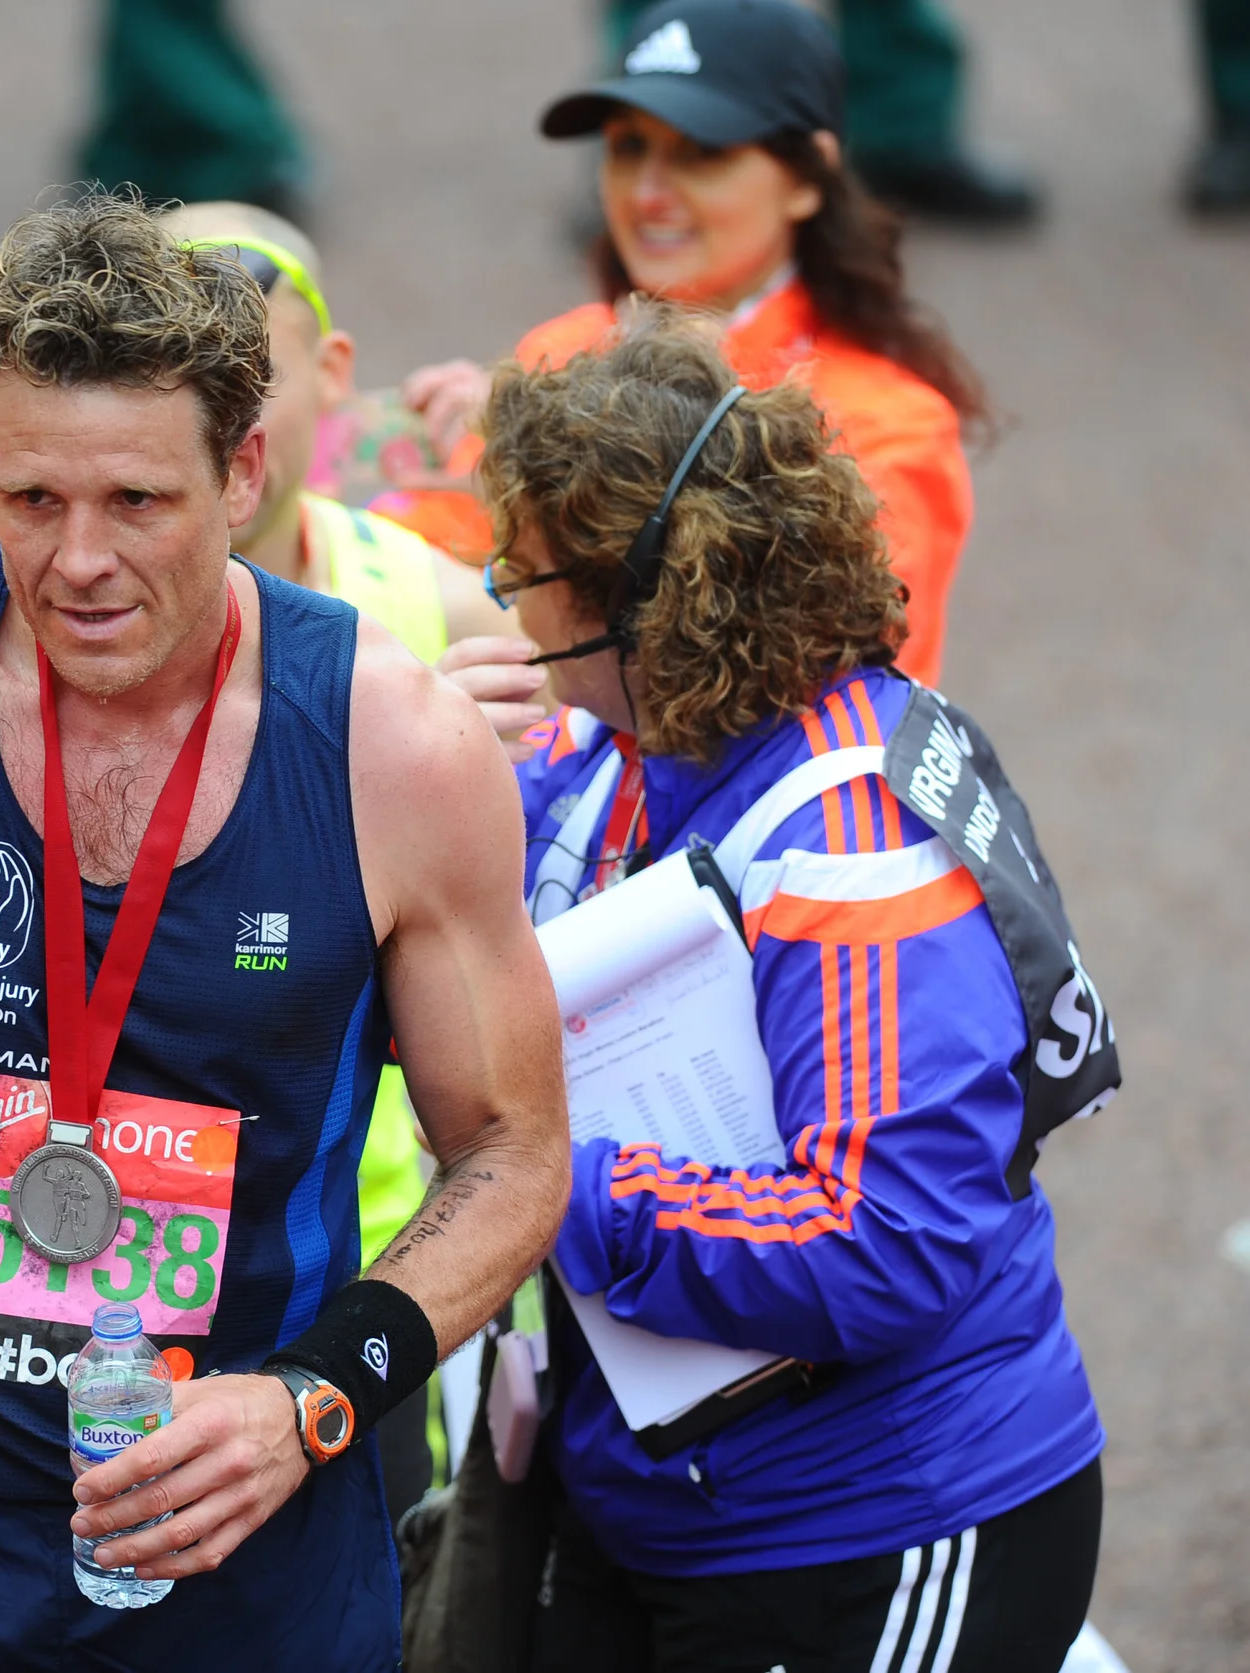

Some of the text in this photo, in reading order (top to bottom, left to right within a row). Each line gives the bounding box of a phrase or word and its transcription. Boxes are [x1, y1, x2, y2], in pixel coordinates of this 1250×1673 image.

[235, 942, 288, 955] karrimor
[234, 954, 287, 971] RUN
[81, 1426, 144, 1446] Buxton
